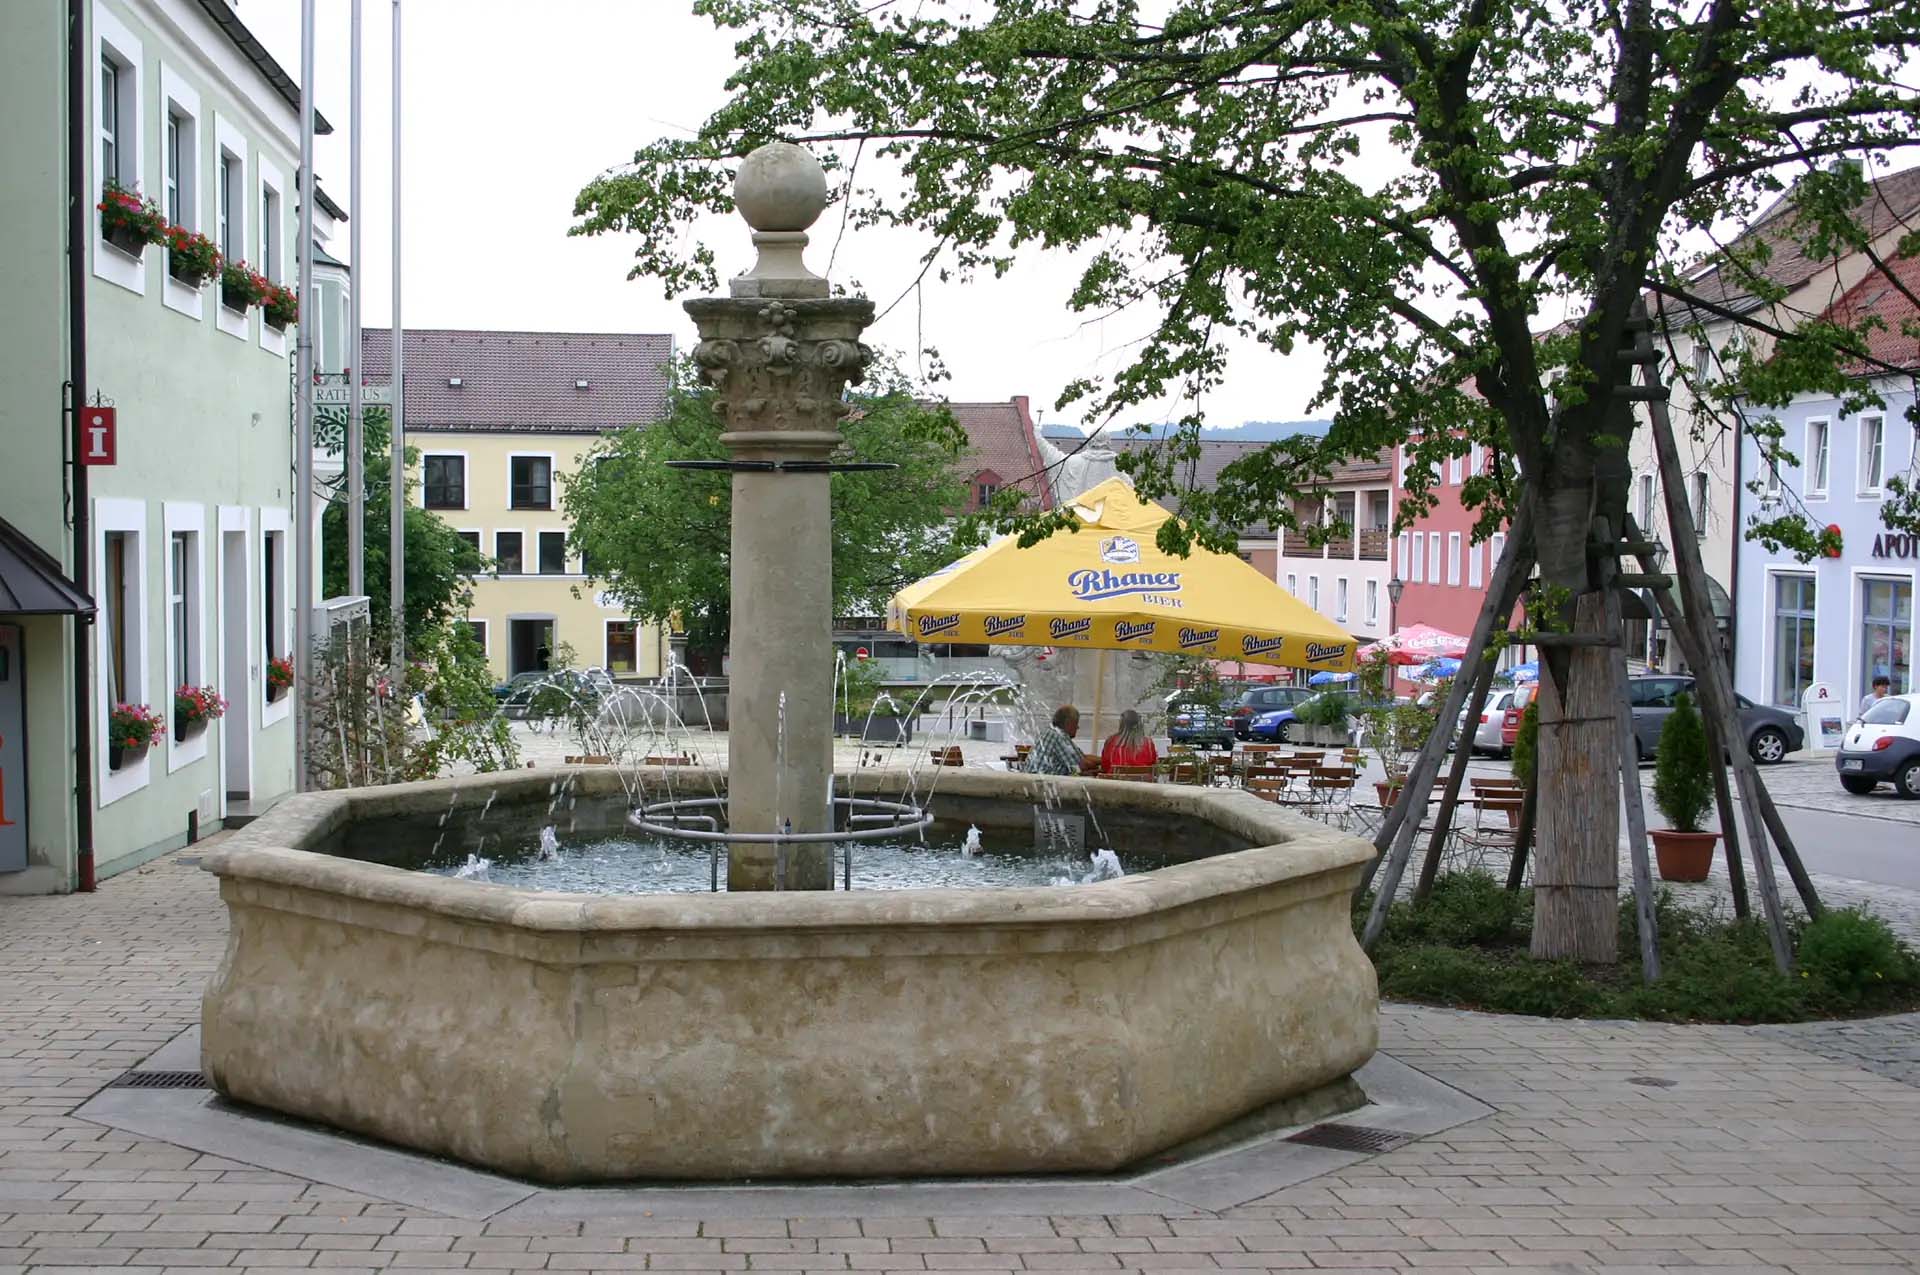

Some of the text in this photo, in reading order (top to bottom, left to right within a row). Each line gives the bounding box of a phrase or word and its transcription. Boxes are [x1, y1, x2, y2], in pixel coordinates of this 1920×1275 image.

[316, 388, 380, 401] RATHUS
[88, 416, 107, 457] i
[1068, 569, 1180, 597] Rhaner
[1142, 593, 1183, 608] BIER
[918, 613, 960, 633] Rhaner
[984, 614, 1026, 633] Rhaner
[1050, 617, 1091, 636] Rhaner
[1115, 620, 1156, 638] Rhaner
[1178, 627, 1220, 645] Rhaner
[1242, 634, 1283, 652] Rhaner
[1306, 642, 1347, 660] Rhaner
